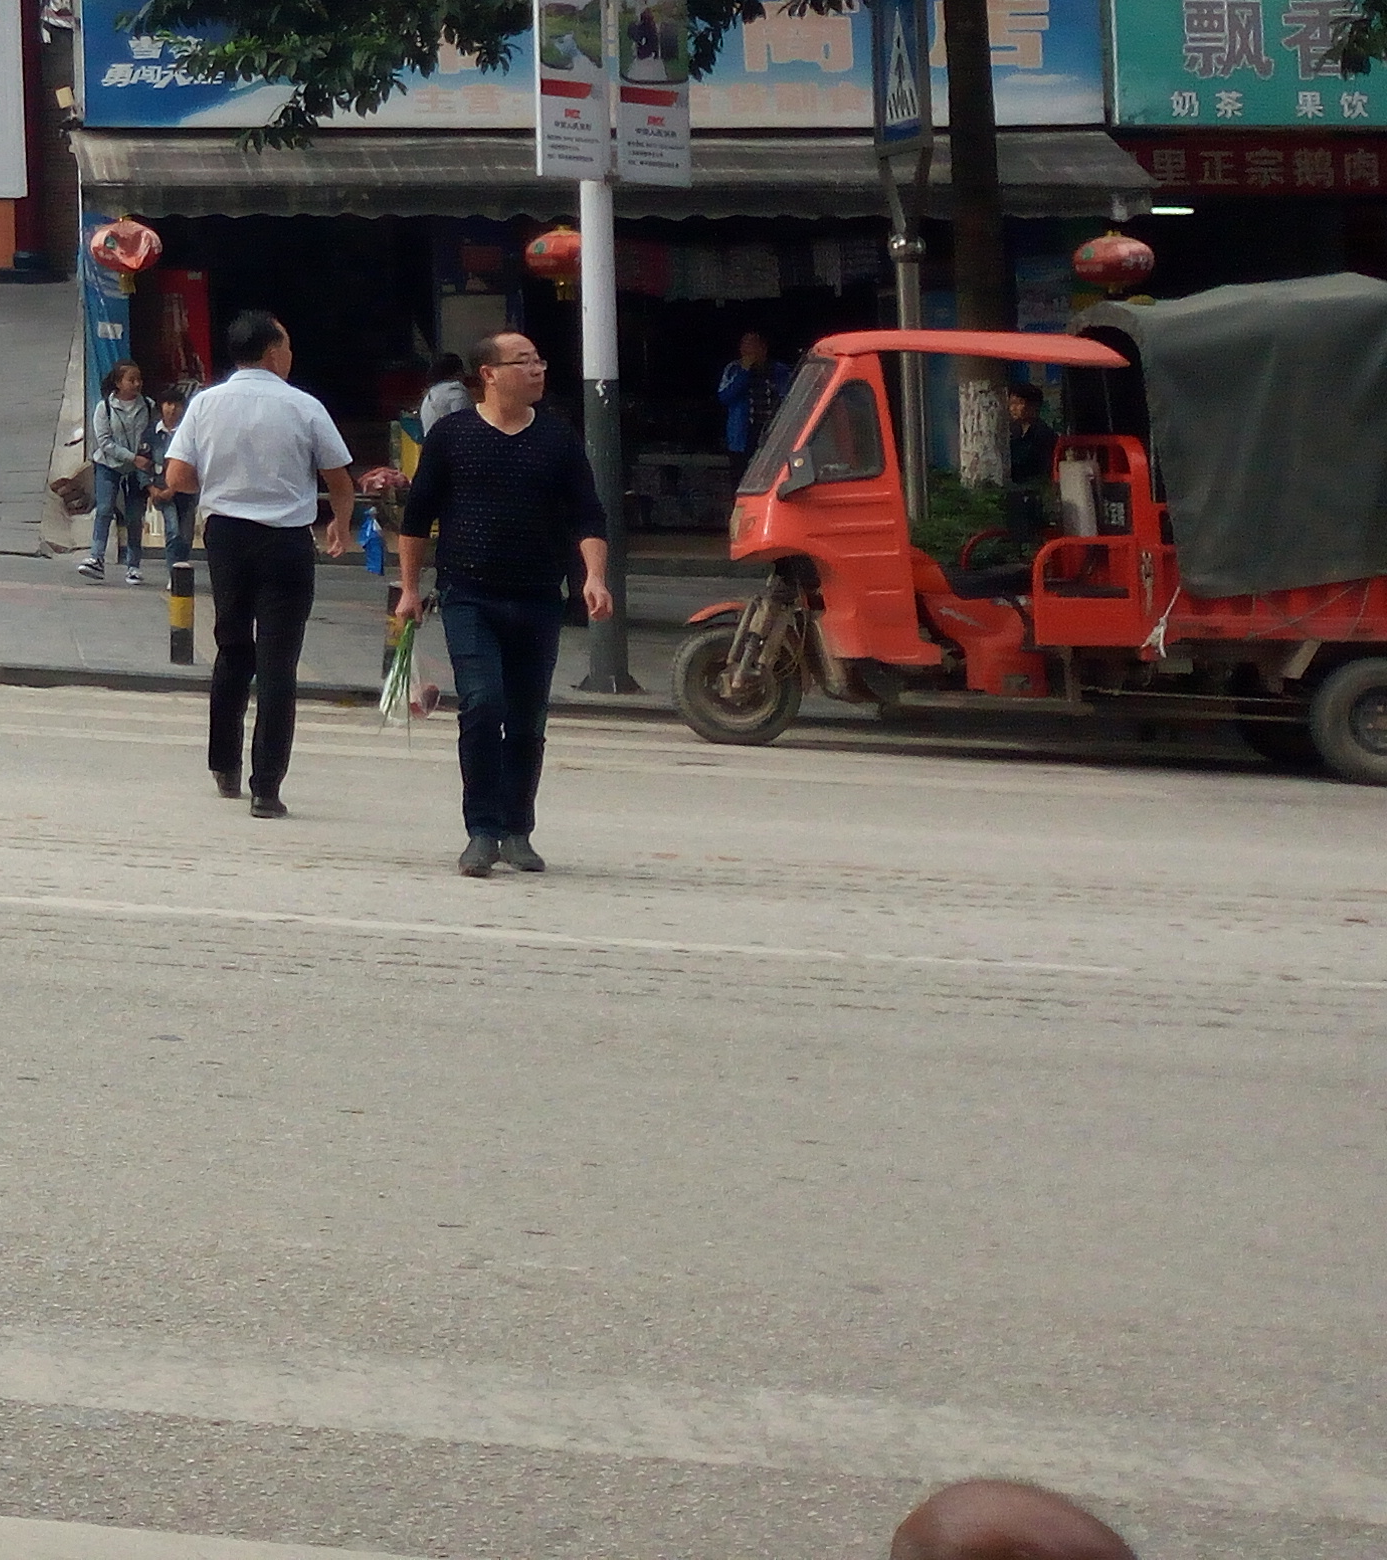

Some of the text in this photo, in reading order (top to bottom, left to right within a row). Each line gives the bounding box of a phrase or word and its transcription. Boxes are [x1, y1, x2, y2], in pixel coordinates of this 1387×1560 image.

[1170, 91, 1369, 119] 奶茶 果饮
[1127, 147, 1381, 190] 里正宗鹅肉
